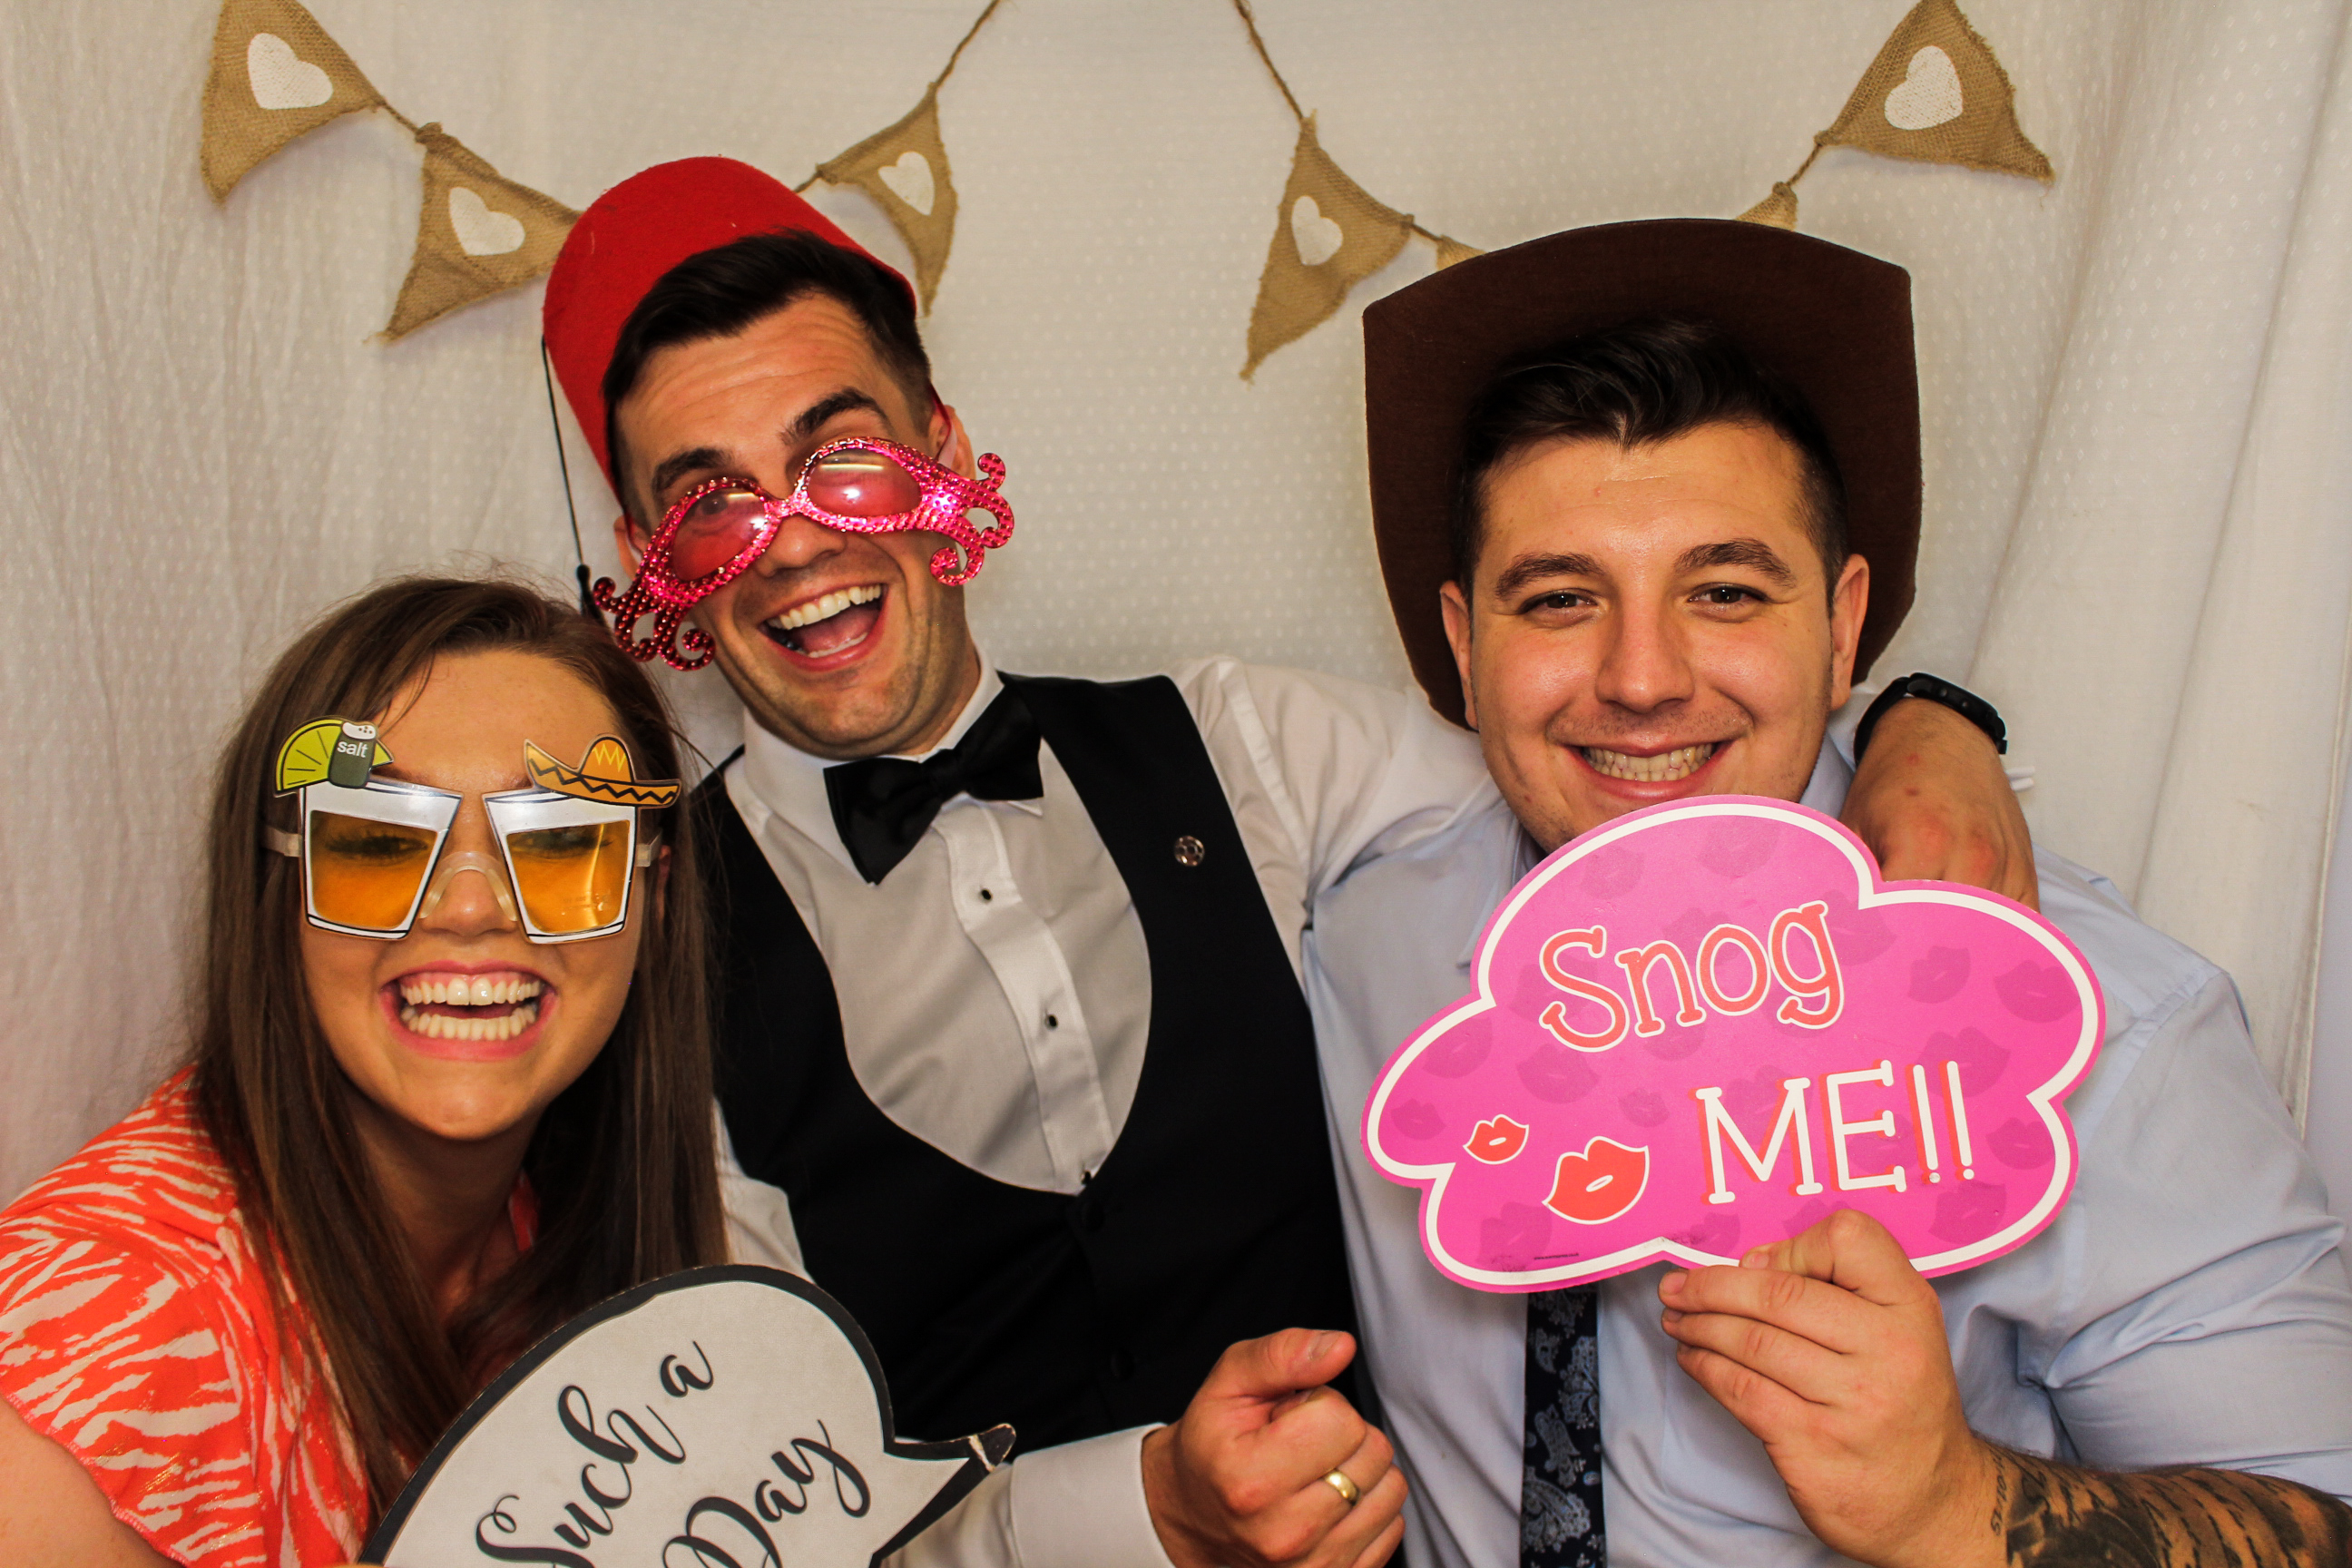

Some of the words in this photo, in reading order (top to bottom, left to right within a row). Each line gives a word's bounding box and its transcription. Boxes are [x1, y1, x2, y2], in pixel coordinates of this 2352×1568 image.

[337, 740, 368, 759] salt
[1538, 900, 1845, 1053] Snog
[1695, 1058, 1975, 1205] ME!!
[659, 1340, 715, 1397] a
[662, 1419, 871, 1568] Day
